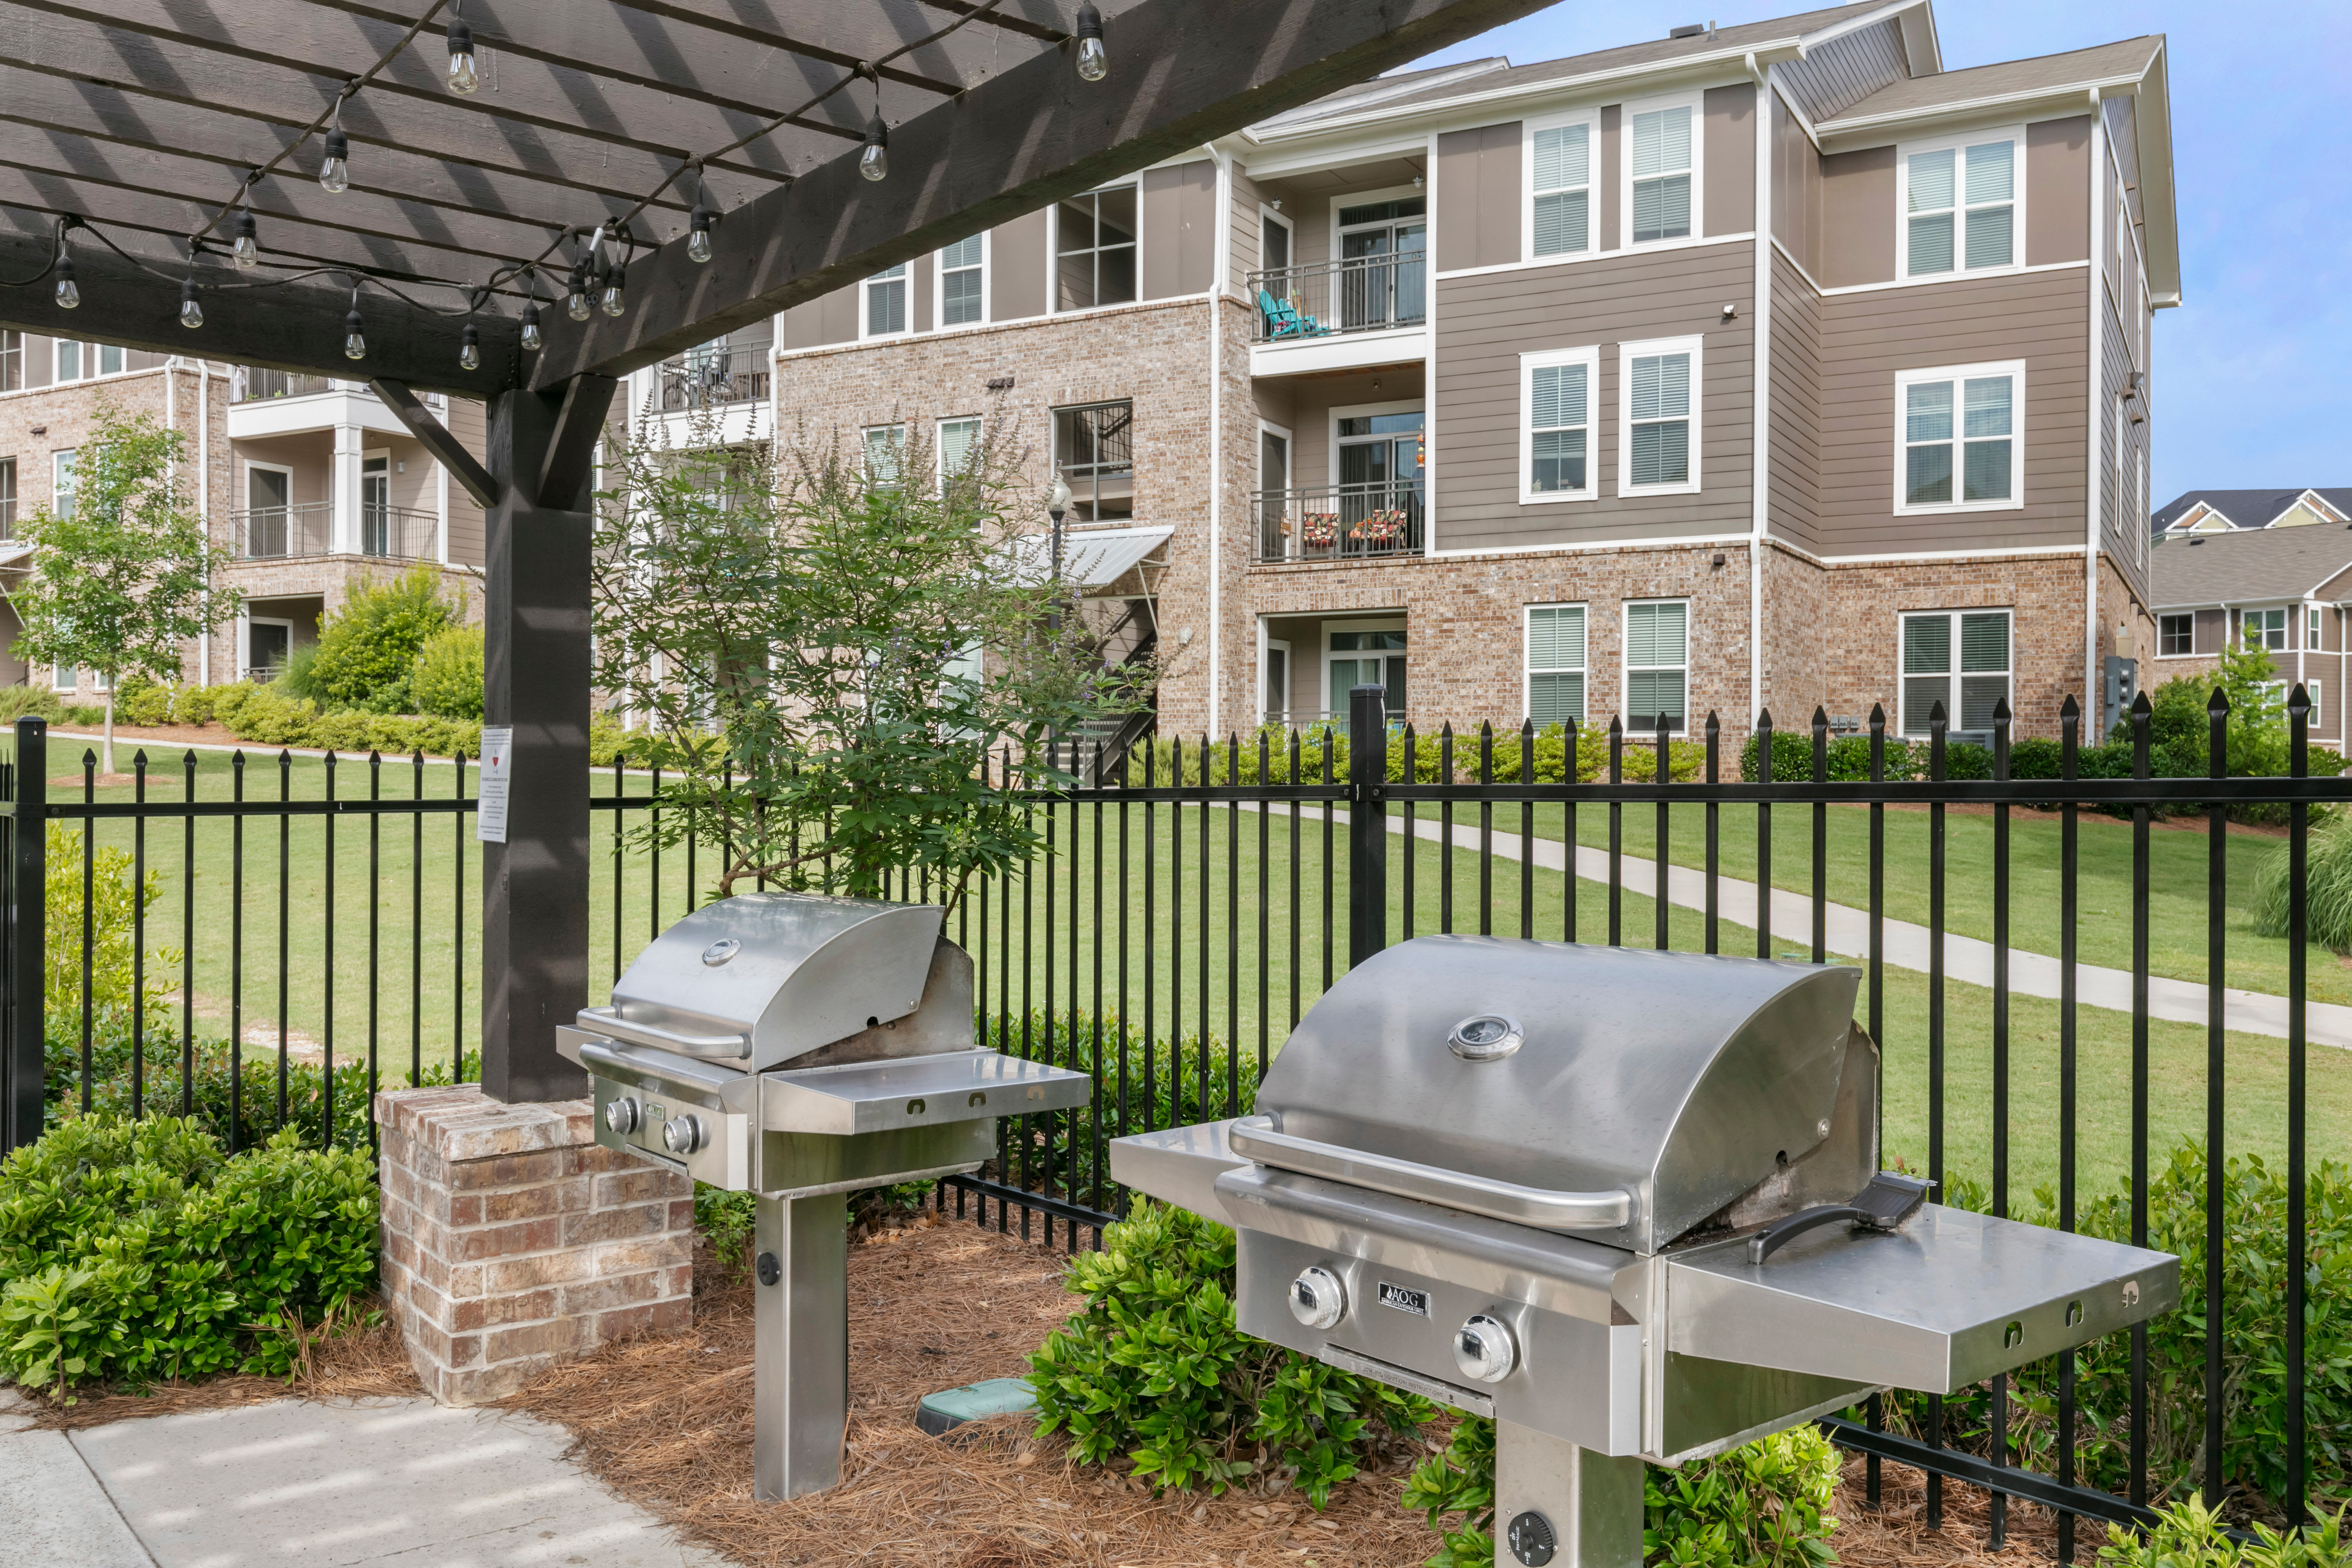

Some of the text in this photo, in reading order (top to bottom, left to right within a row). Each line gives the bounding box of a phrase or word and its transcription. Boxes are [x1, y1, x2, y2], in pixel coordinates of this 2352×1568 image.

[1391, 1288, 1418, 1307] AOG
[1362, 1366, 1383, 1378] LIGHING
[1408, 1382, 1443, 1398] INSTRUCTIONS
